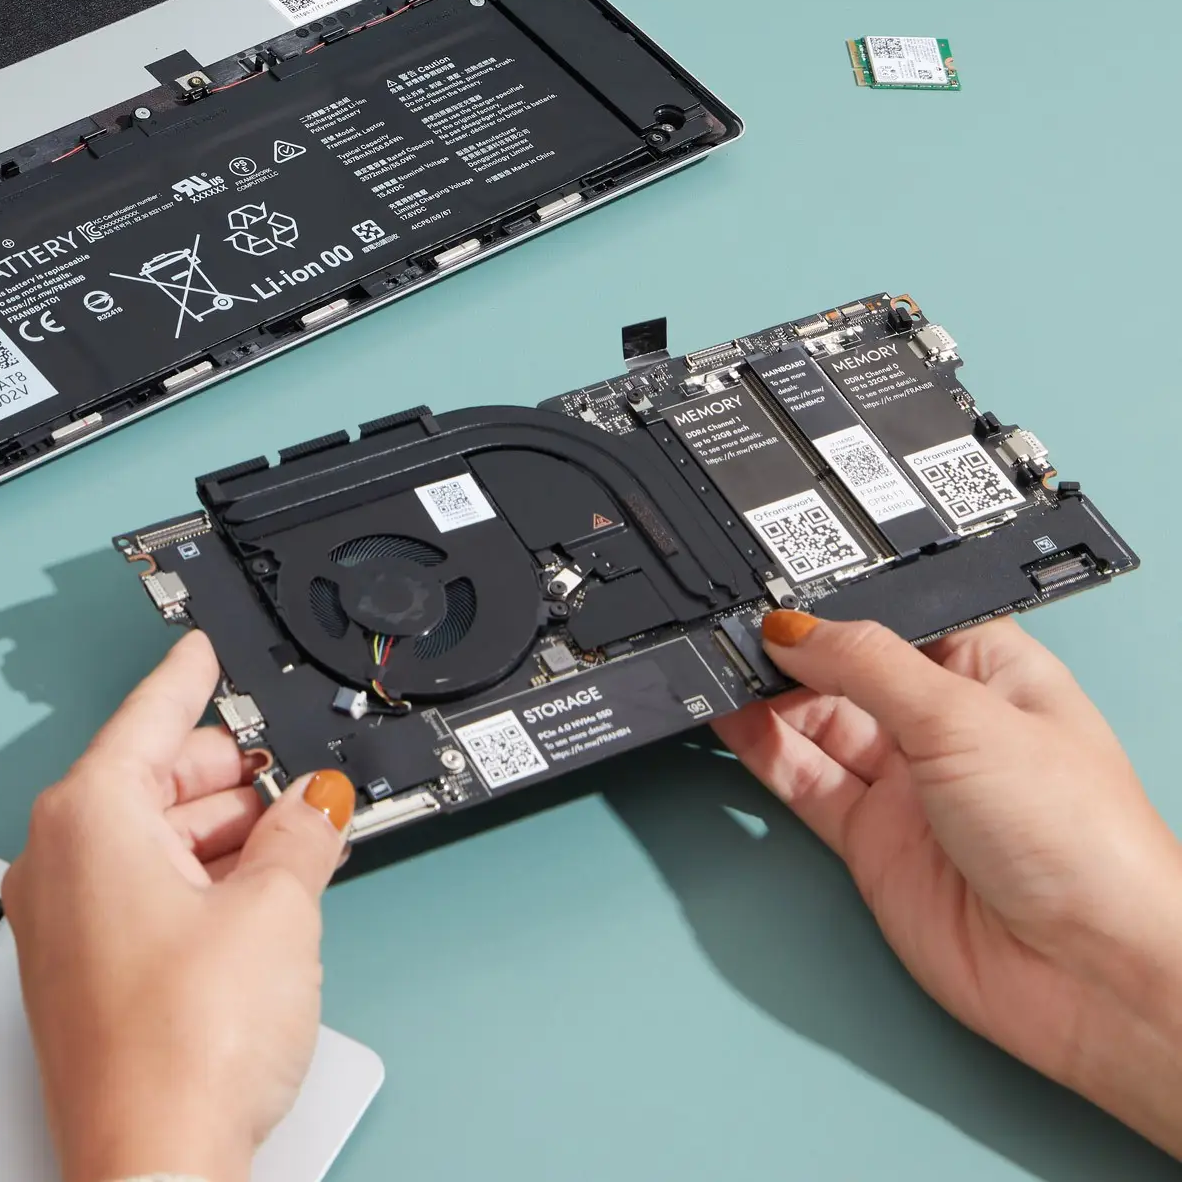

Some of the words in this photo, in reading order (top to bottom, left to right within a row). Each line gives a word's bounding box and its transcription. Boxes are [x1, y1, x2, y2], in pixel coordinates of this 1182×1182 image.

[417, 56, 451, 73] Caution
[414, 95, 427, 104] not
[425, 79, 466, 99] disassemble,
[465, 67, 496, 83] puncture,
[494, 58, 516, 69] crush,
[410, 104, 424, 114] tear
[430, 95, 448, 104] burn
[446, 90, 459, 98] the
[426, 117, 449, 130] Please
[448, 112, 461, 121] use
[459, 107, 472, 115] the
[471, 96, 496, 110] charger
[495, 83, 525, 100] specified
[304, 107, 349, 129] Rechargeable
[347, 98, 368, 109] Li-ion
[309, 120, 337, 135] Polymer
[336, 108, 361, 123] Battery
[441, 123, 454, 131] the
[453, 111, 478, 126] original
[326, 131, 363, 150] Framework
[361, 121, 386, 135] Laptop
[334, 126, 357, 139] Model
[448, 128, 462, 137] pas
[475, 126, 518, 148] Manufacturer
[336, 146, 362, 160] Typical
[360, 133, 390, 150] Capacity
[386, 149, 407, 163] Rated
[405, 138, 435, 153] Capacity
[467, 150, 501, 168] Dongguan
[500, 138, 529, 154] Amperex
[472, 154, 511, 173] Technology
[508, 142, 534, 157] Limited
[397, 165, 426, 182] Nominal
[423, 156, 450, 169] Voltage
[510, 162, 530, 173] Made
[535, 150, 556, 161] China
[234, 167, 273, 187] FRAMEWORK
[236, 175, 269, 192] COMPUTER
[189, 183, 229, 204] XXXXXX
[376, 183, 405, 199] 15.4VDC
[393, 200, 420, 216] Limited
[418, 187, 450, 204] Charging
[446, 177, 474, 192] Voltage
[102, 203, 138, 221] Certification
[136, 194, 159, 207] number
[399, 206, 427, 221] 17.6VDC
[4, 276, 36, 294] battery
[43, 254, 91, 278] replaceable
[250, 261, 325, 300] Li-ion
[320, 244, 354, 268] 00
[5, 294, 21, 304] see
[20, 283, 43, 297] more
[42, 272, 73, 287] details:
[831, 343, 899, 373] MEMORY
[761, 359, 807, 380] MAINBOARD
[790, 372, 807, 380] more
[843, 374, 865, 385] DDR4
[864, 364, 893, 379] Channel
[867, 375, 889, 387] 32GB
[888, 369, 906, 379] each
[777, 384, 798, 395] details:
[877, 384, 896, 394] more
[895, 376, 917, 388] details:
[673, 394, 742, 427] MEMORY
[685, 427, 707, 439] DDR4
[707, 417, 736, 432] Channel
[711, 430, 733, 442] 32GB
[732, 424, 750, 435] each
[721, 440, 739, 449] more
[739, 432, 761, 443] details:
[922, 441, 974, 463] framework
[763, 496, 815, 518] framework
[523, 686, 603, 724] STORAGE
[570, 715, 597, 729] NVMe
[595, 708, 613, 720] SSD
